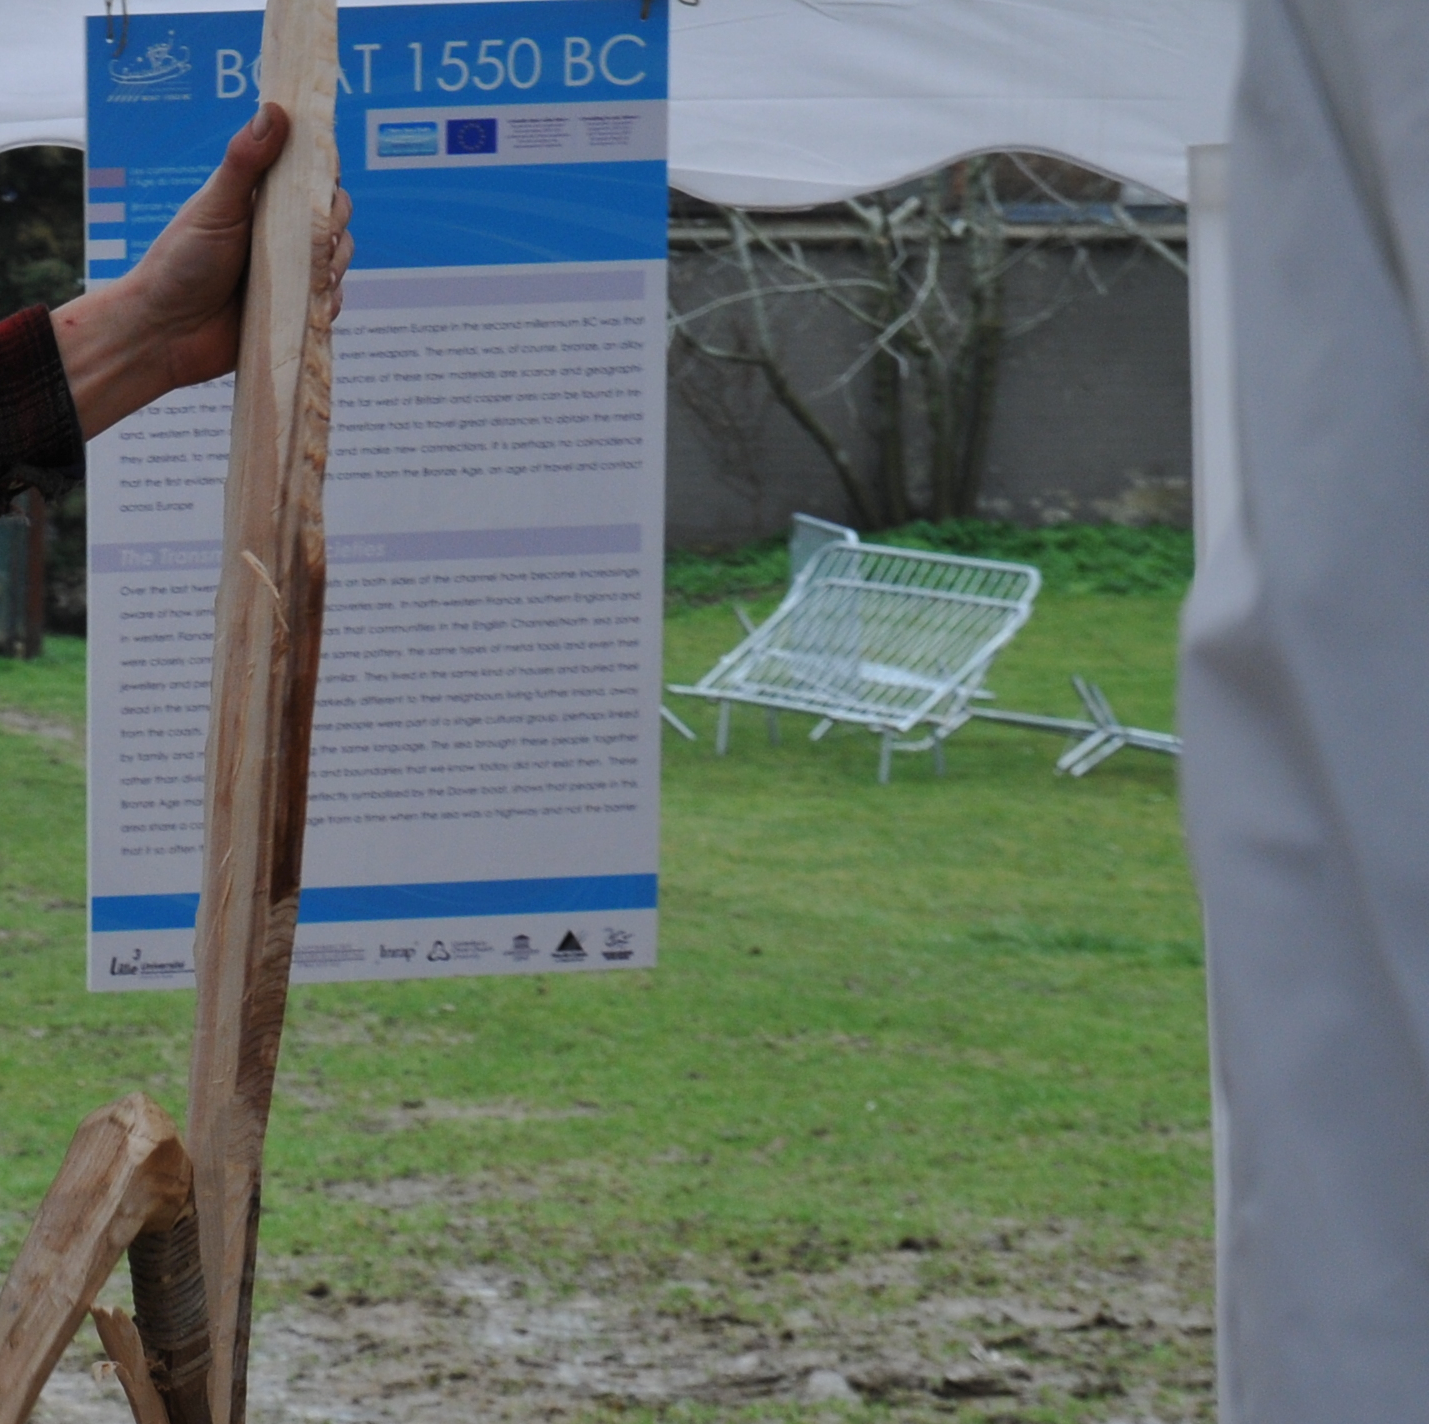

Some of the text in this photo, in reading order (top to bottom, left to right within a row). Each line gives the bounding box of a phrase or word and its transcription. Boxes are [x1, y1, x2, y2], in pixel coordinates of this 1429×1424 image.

[215, 33, 647, 99] BT 1550 BC
[120, 549, 154, 568] The
